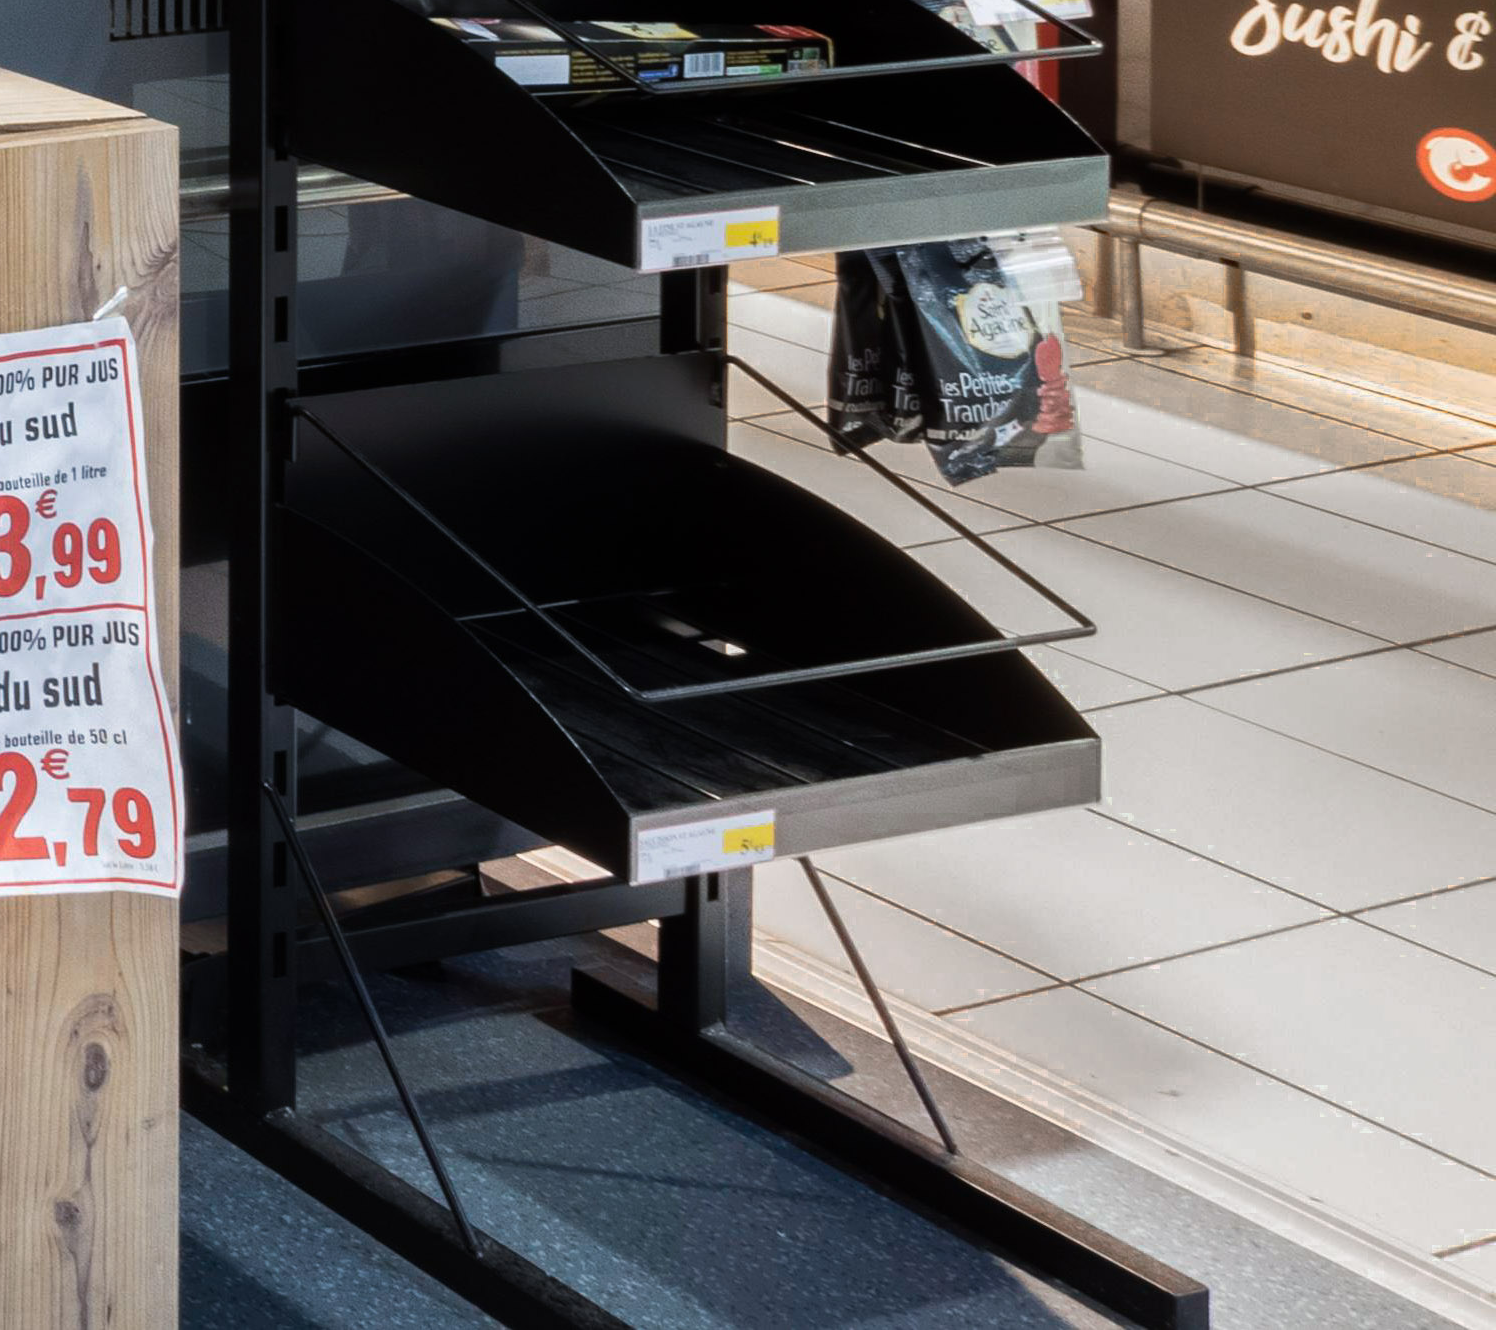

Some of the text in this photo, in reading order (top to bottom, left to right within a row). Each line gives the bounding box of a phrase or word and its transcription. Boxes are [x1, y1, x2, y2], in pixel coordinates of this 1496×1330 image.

[1446, 10, 1493, 71] &
[42, 364, 79, 389] PUR
[86, 357, 119, 383] JUS
[25, 402, 78, 441] sud
[54, 469, 68, 485] de
[71, 467, 77, 482] 1
[81, 465, 108, 480] litre
[52, 623, 95, 648] PUR
[102, 620, 140, 646] JUS
[43, 662, 103, 708] sud
[4, 731, 63, 748] bouteille
[68, 730, 85, 745] de
[89, 729, 108, 745] 50
[112, 729, 128, 746] cl
